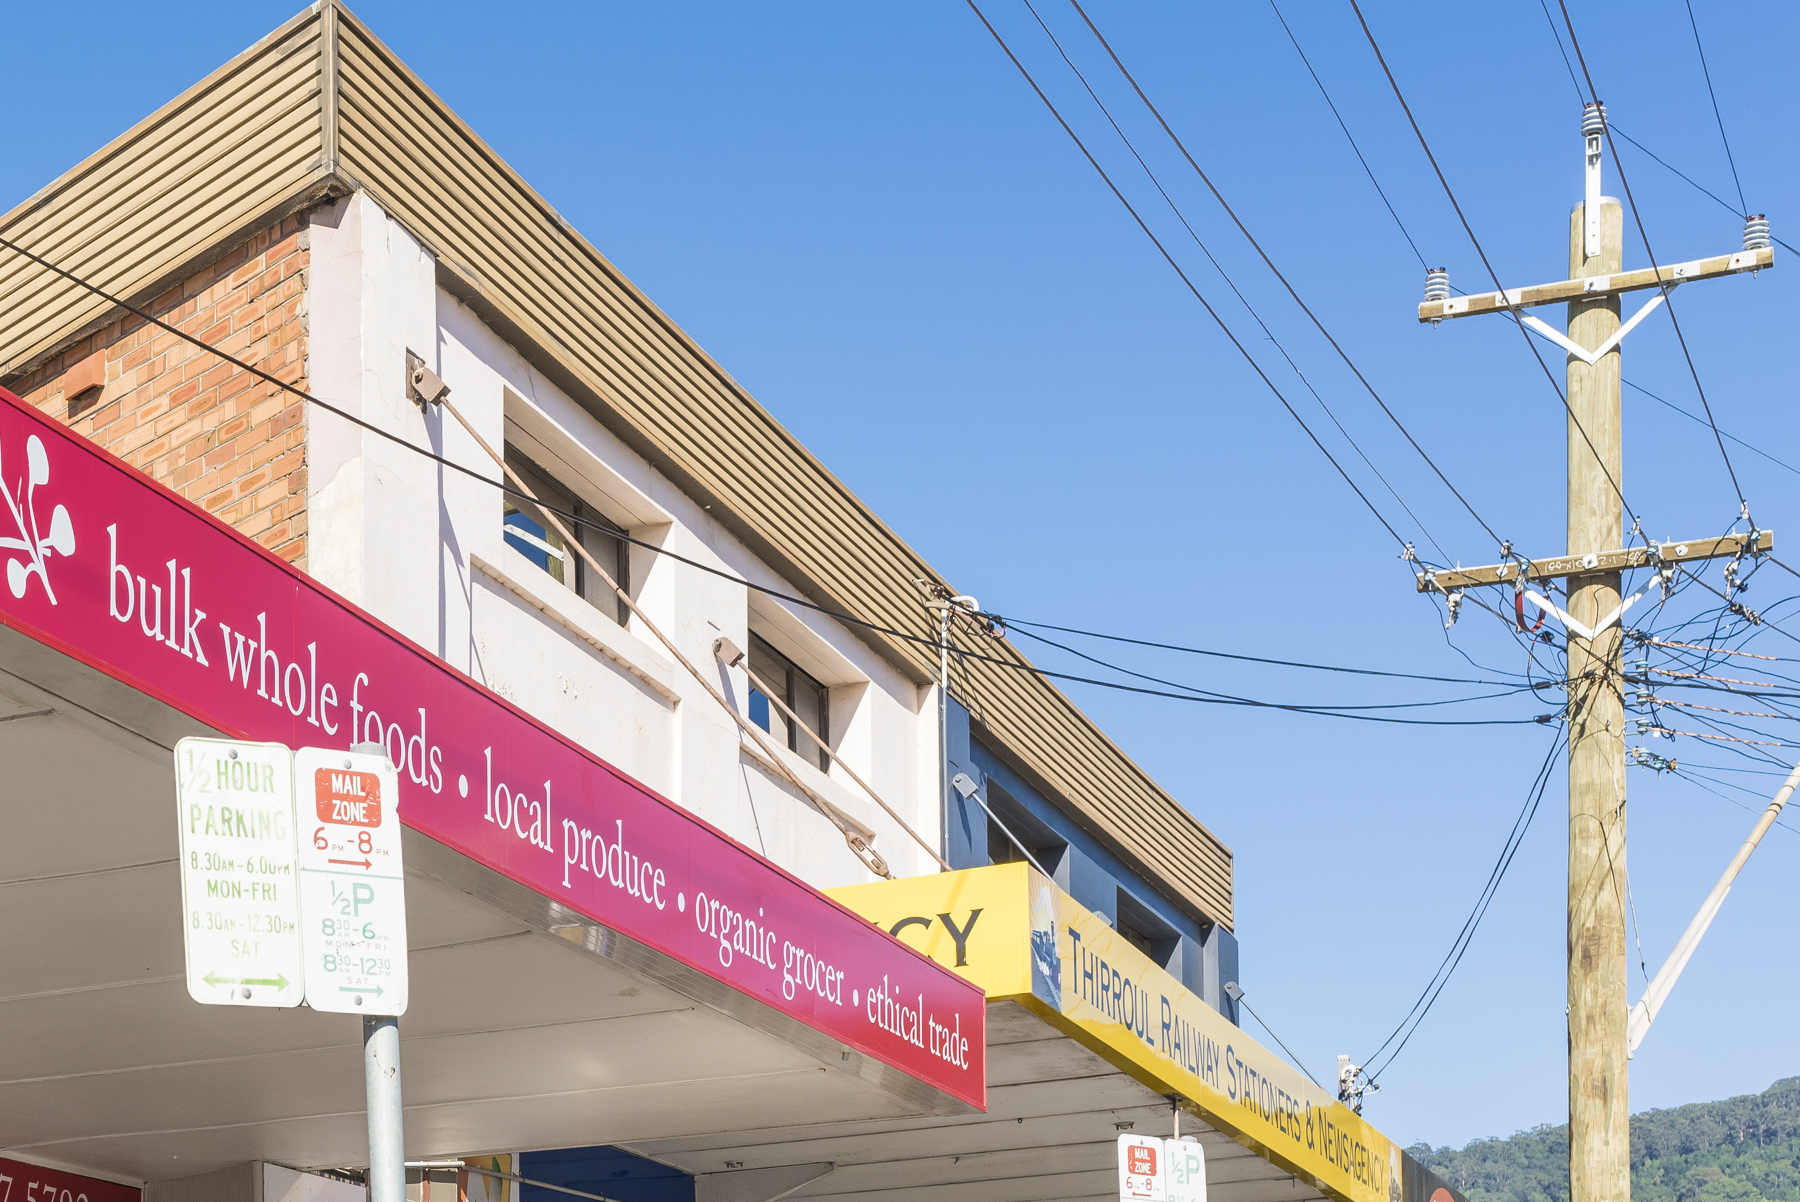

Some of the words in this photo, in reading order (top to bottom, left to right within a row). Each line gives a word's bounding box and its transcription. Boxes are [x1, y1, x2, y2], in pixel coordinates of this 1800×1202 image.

[216, 759, 275, 793] HOUR
[331, 773, 366, 797] MAIL
[106, 523, 209, 668] bulk
[219, 612, 338, 736] whole
[349, 672, 443, 795] foods
[483, 746, 554, 853] local
[562, 817, 666, 911] produce
[695, 892, 777, 970] organic
[783, 940, 844, 1007] grocer
[866, 975, 924, 1050] ethical
[928, 1014, 969, 1071] trade
[189, 803, 287, 841] PARKING
[332, 800, 369, 823] ZONE
[207, 879, 277, 901] MON-FRI
[230, 939, 260, 959] SAT
[1066, 926, 1155, 1048] THIRROUL
[1160, 993, 1220, 1090] RAILWAY
[1225, 1043, 1302, 1144] STATIONERS
[1305, 1099, 1315, 1151] &
[1318, 1107, 1385, 1197] NEWSAGENCY
[1134, 1147, 1151, 1161] MAIL
[1134, 1161, 1152, 1174] ZONE
